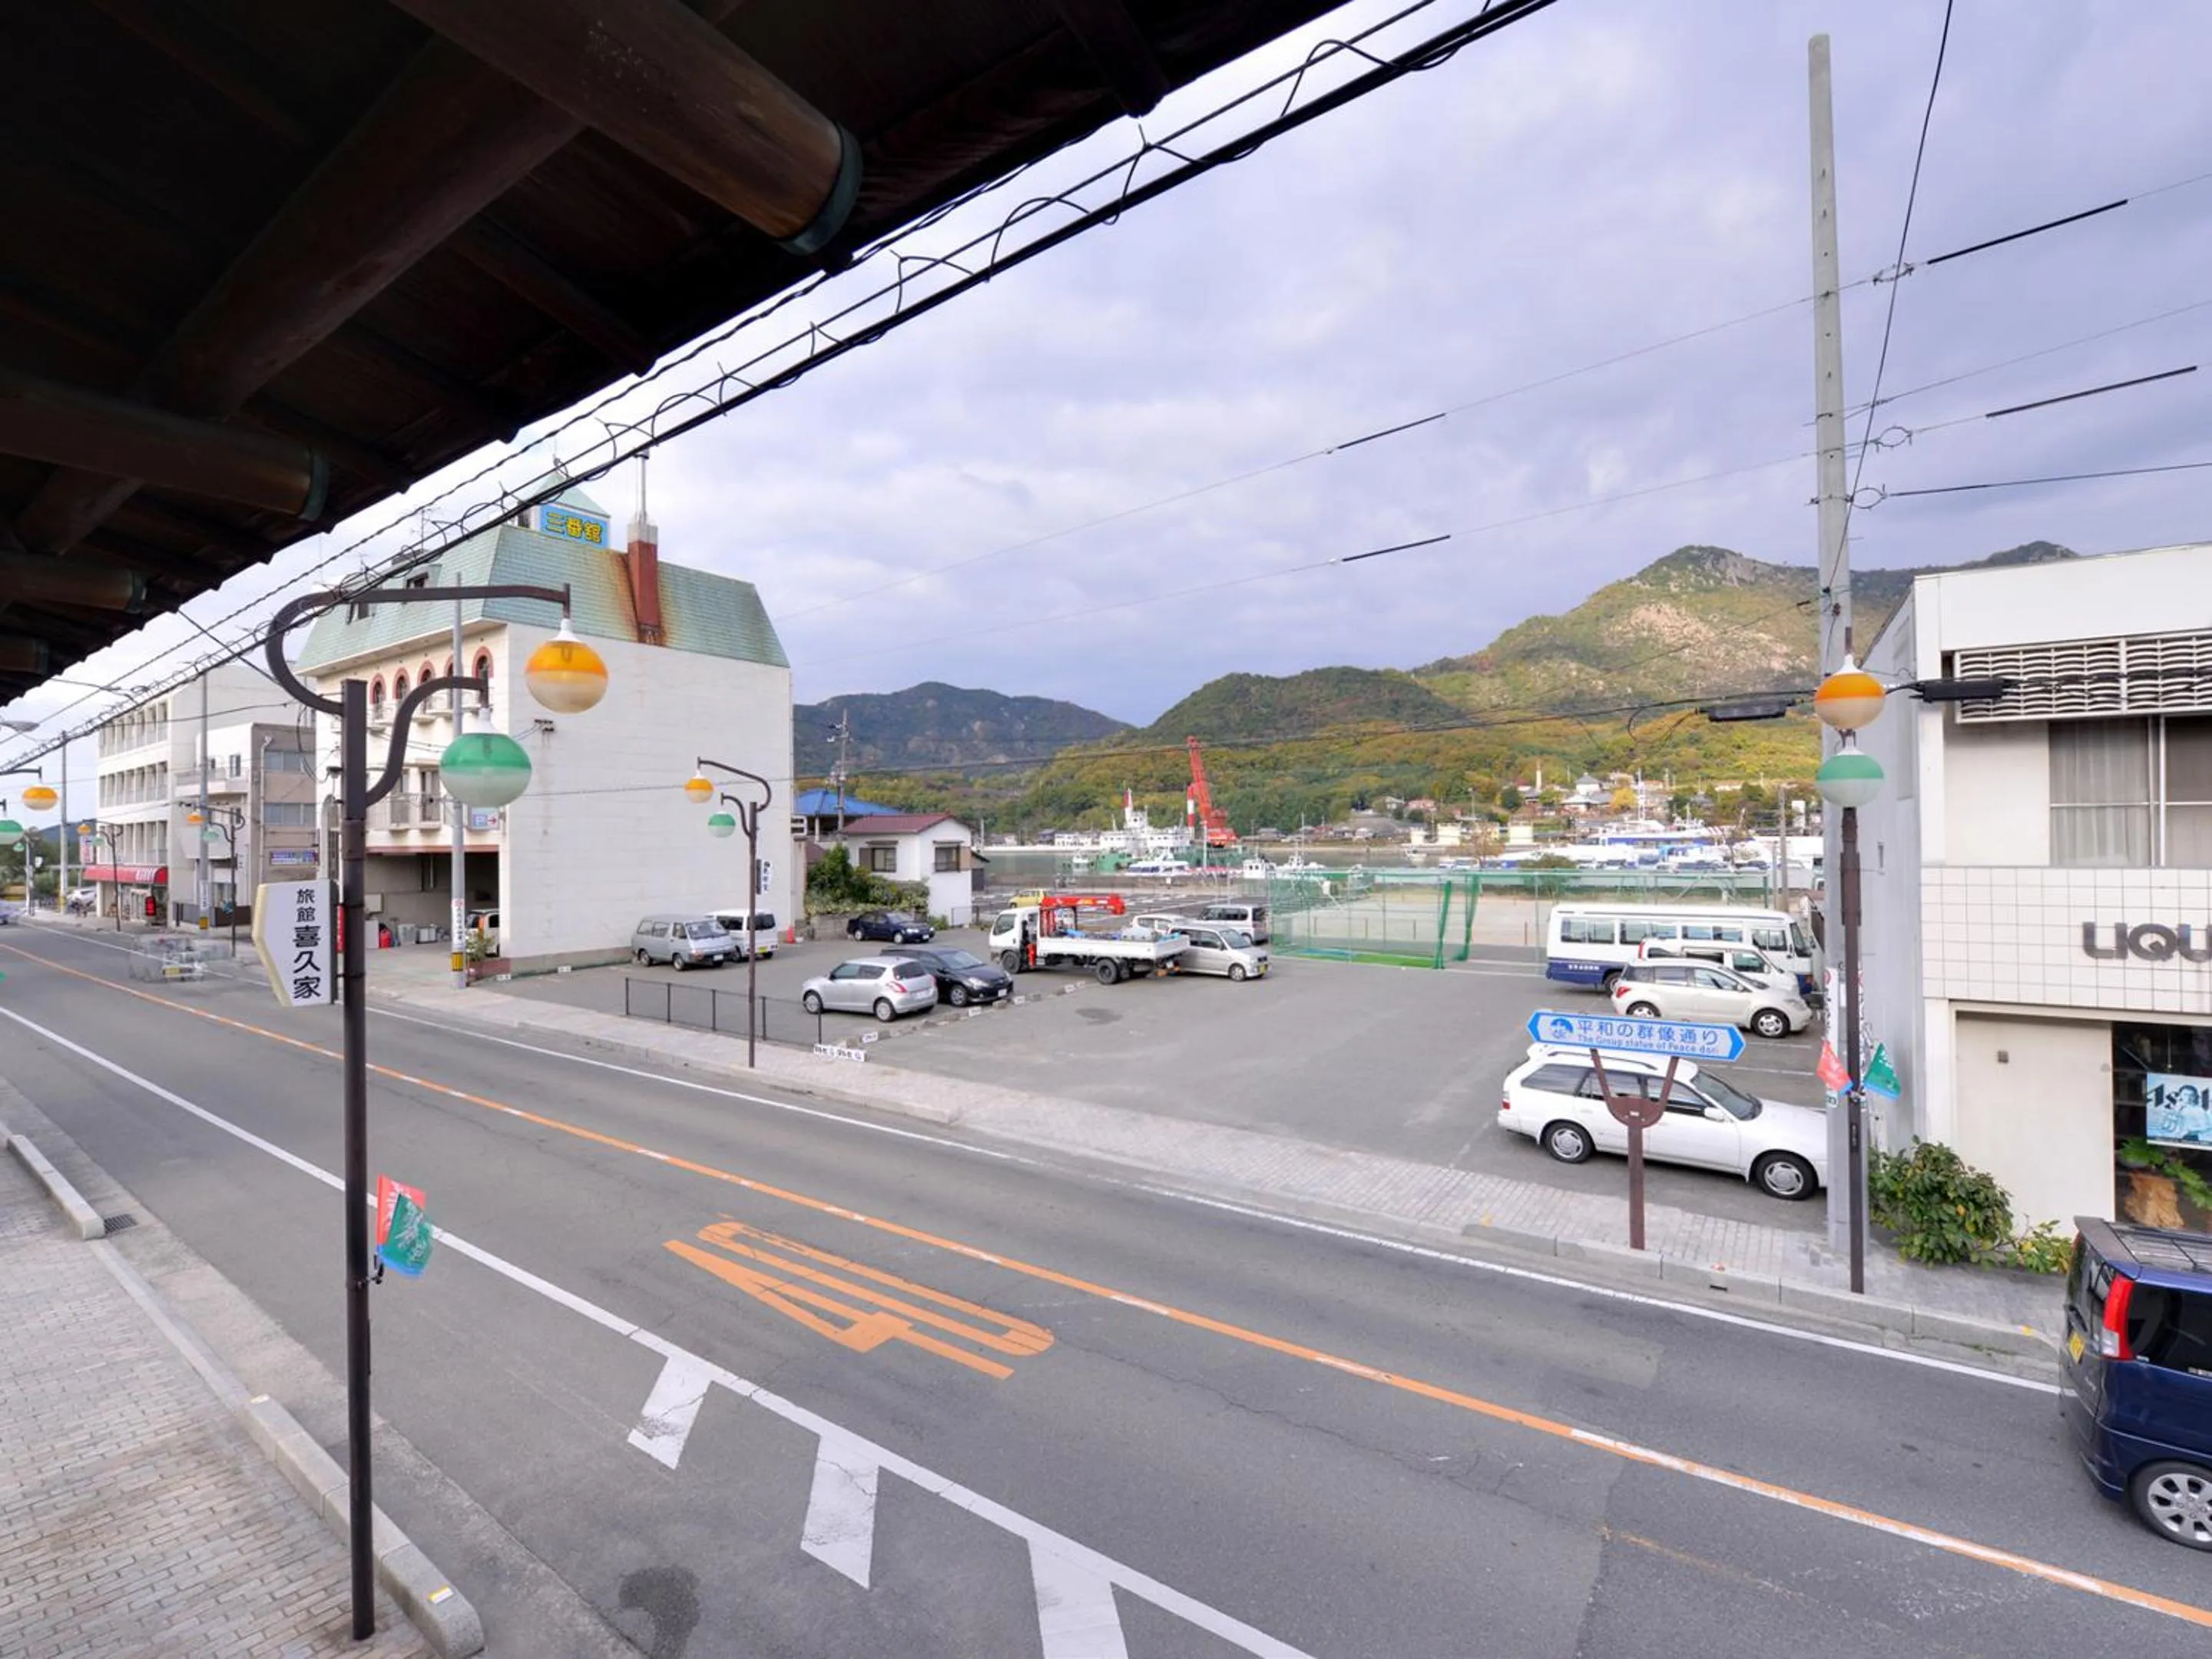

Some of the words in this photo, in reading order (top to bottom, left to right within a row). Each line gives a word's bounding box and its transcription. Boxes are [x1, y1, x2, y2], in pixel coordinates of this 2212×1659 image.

[293, 889, 321, 999] 旅館喜久家
[1578, 1020, 1717, 1045] 平和の群像通り
